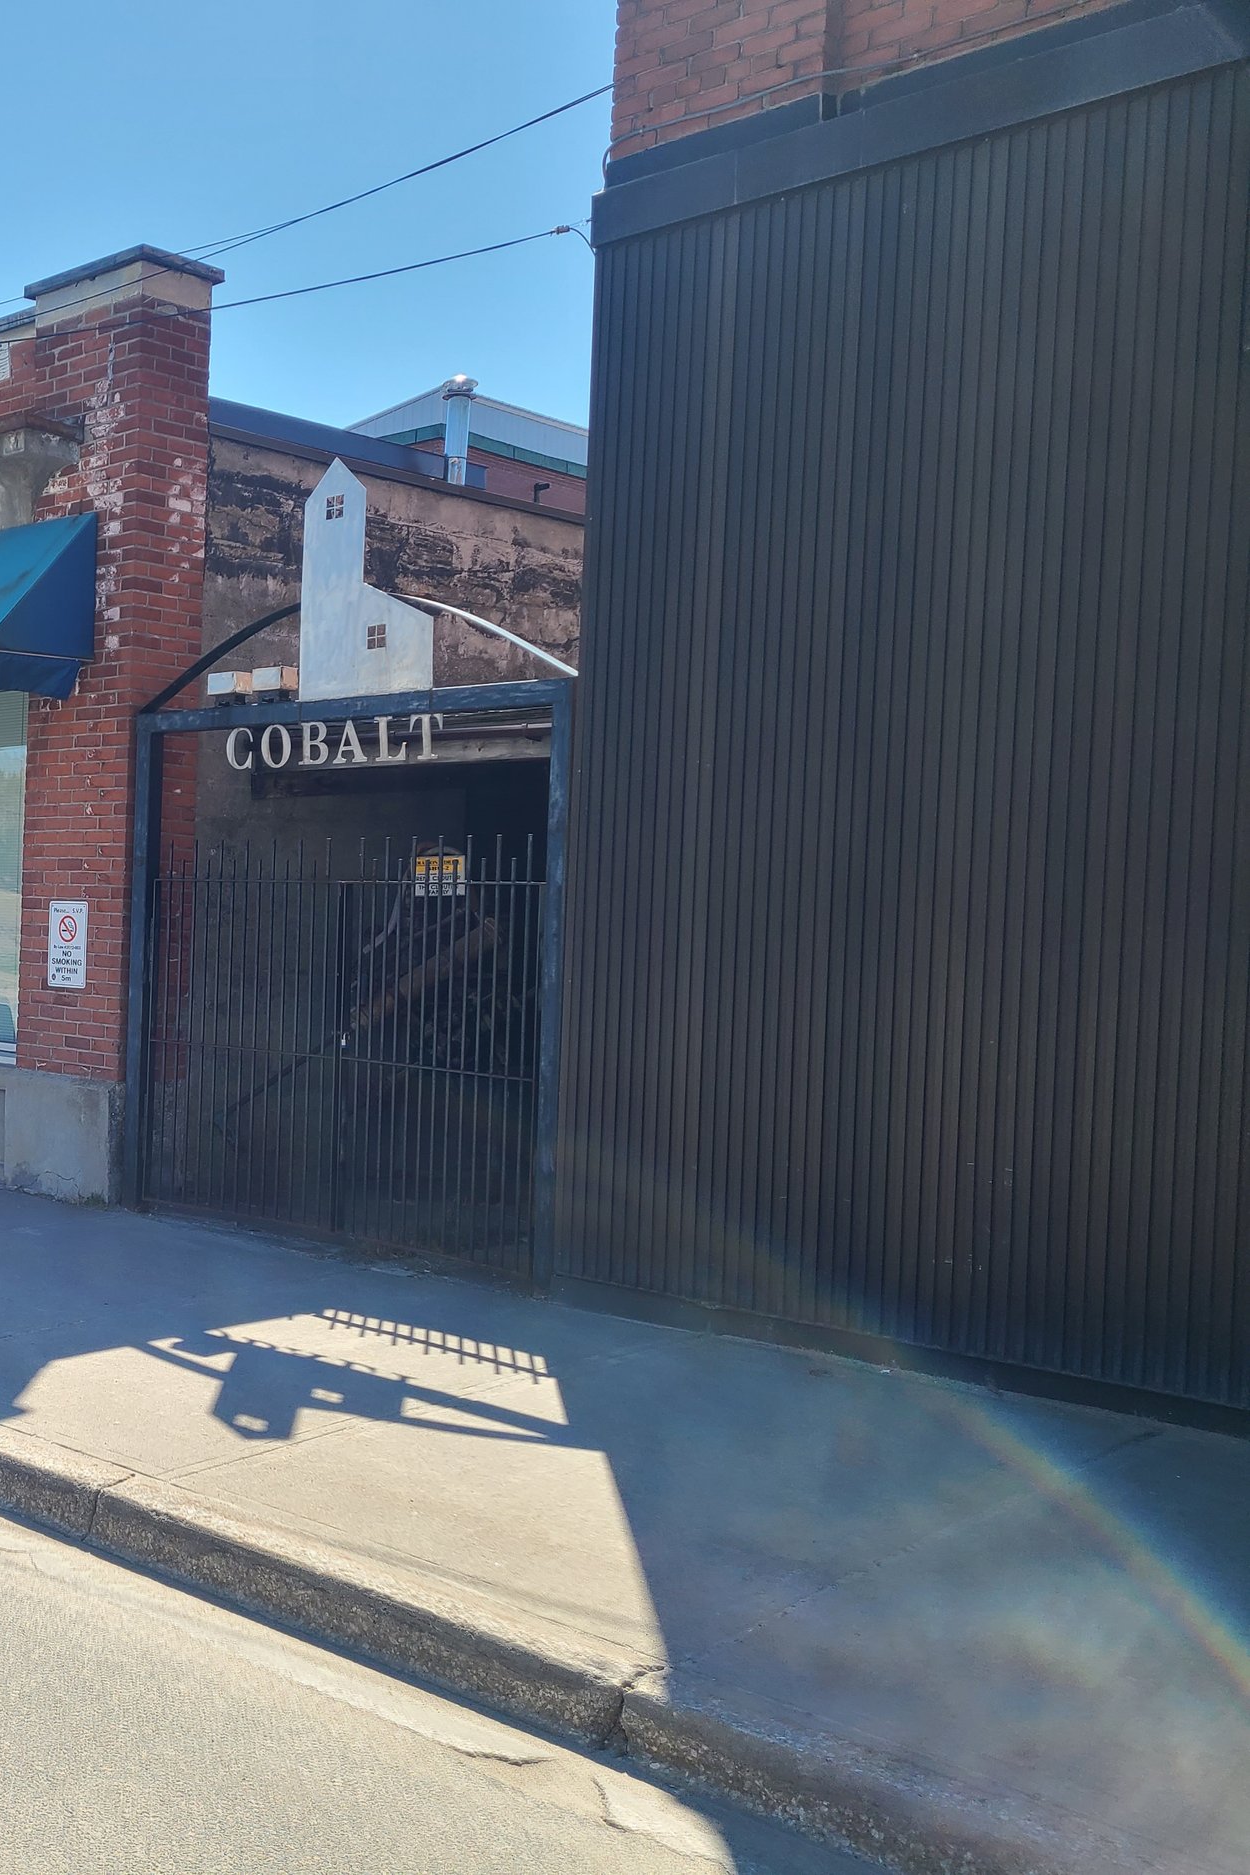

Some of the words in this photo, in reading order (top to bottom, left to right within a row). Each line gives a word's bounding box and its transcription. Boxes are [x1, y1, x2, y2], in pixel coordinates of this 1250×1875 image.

[226, 713, 444, 770] COBALT
[61, 950, 72, 958] NO
[51, 957, 83, 967] SMOKING
[55, 966, 78, 975] WITHIN
